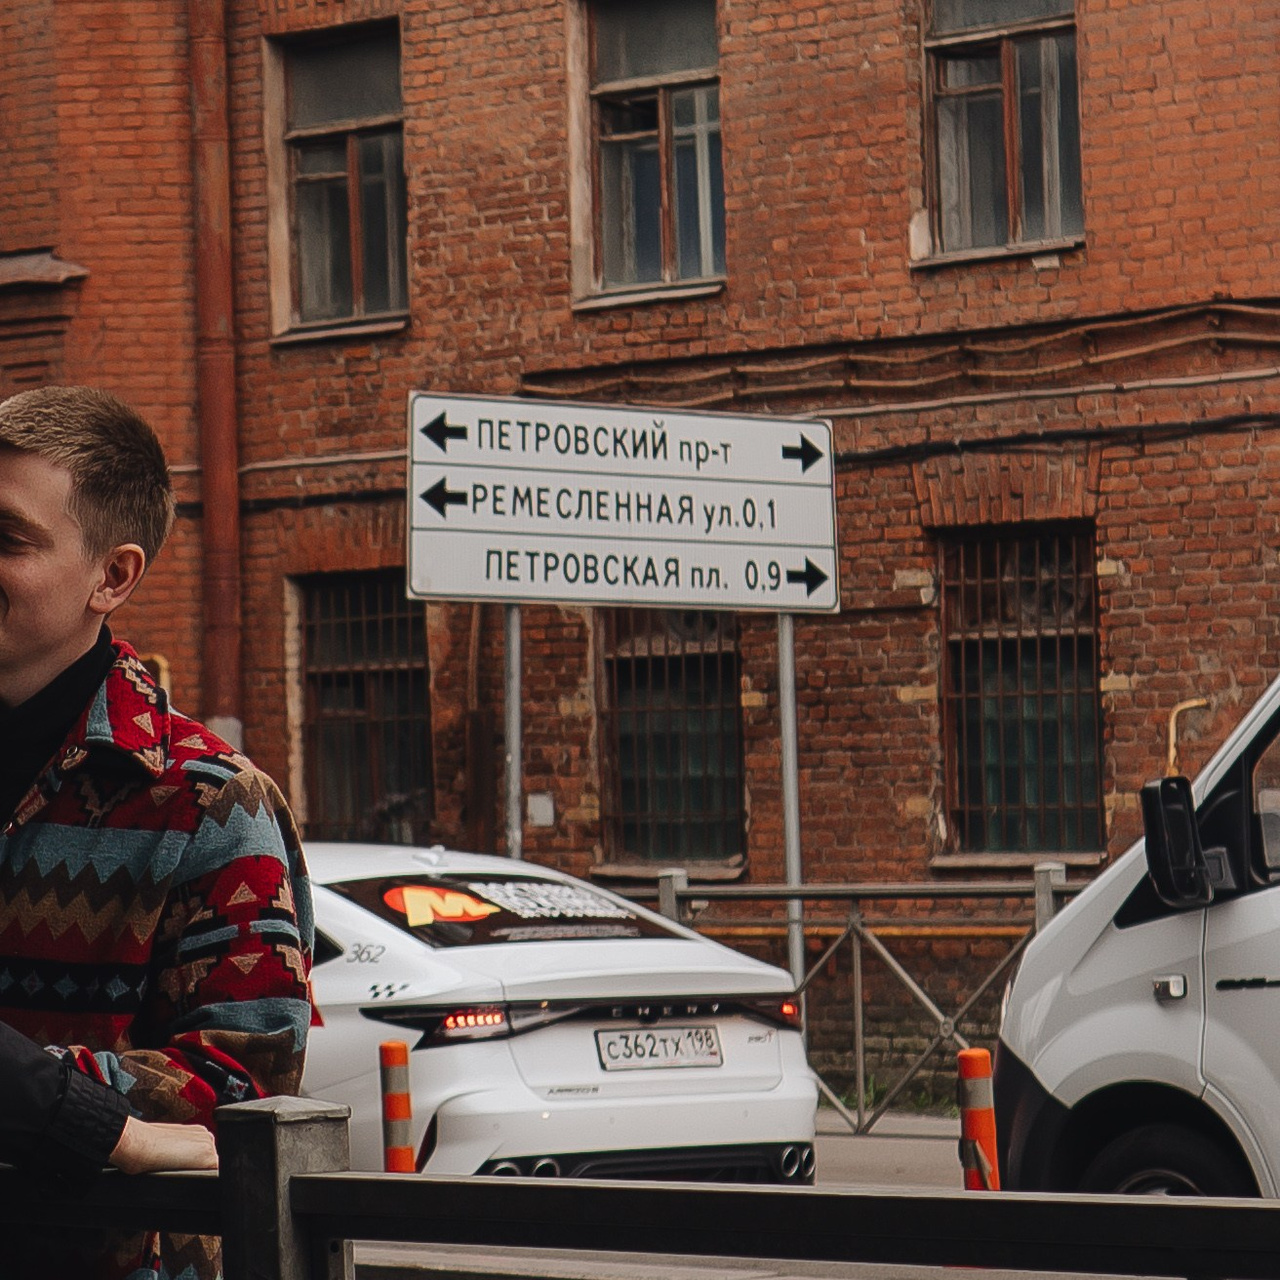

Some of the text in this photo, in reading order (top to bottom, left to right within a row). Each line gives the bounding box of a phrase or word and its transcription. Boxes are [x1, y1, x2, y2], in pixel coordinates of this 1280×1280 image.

[477, 418, 732, 470] ПЕТРОВСКИЙ пр-т
[472, 483, 694, 525] РЕМЕСЛЕННАЯ
[485, 549, 782, 592] ПЕТРОВСКАЯ пл. 0,9
[346, 943, 387, 963] 362
